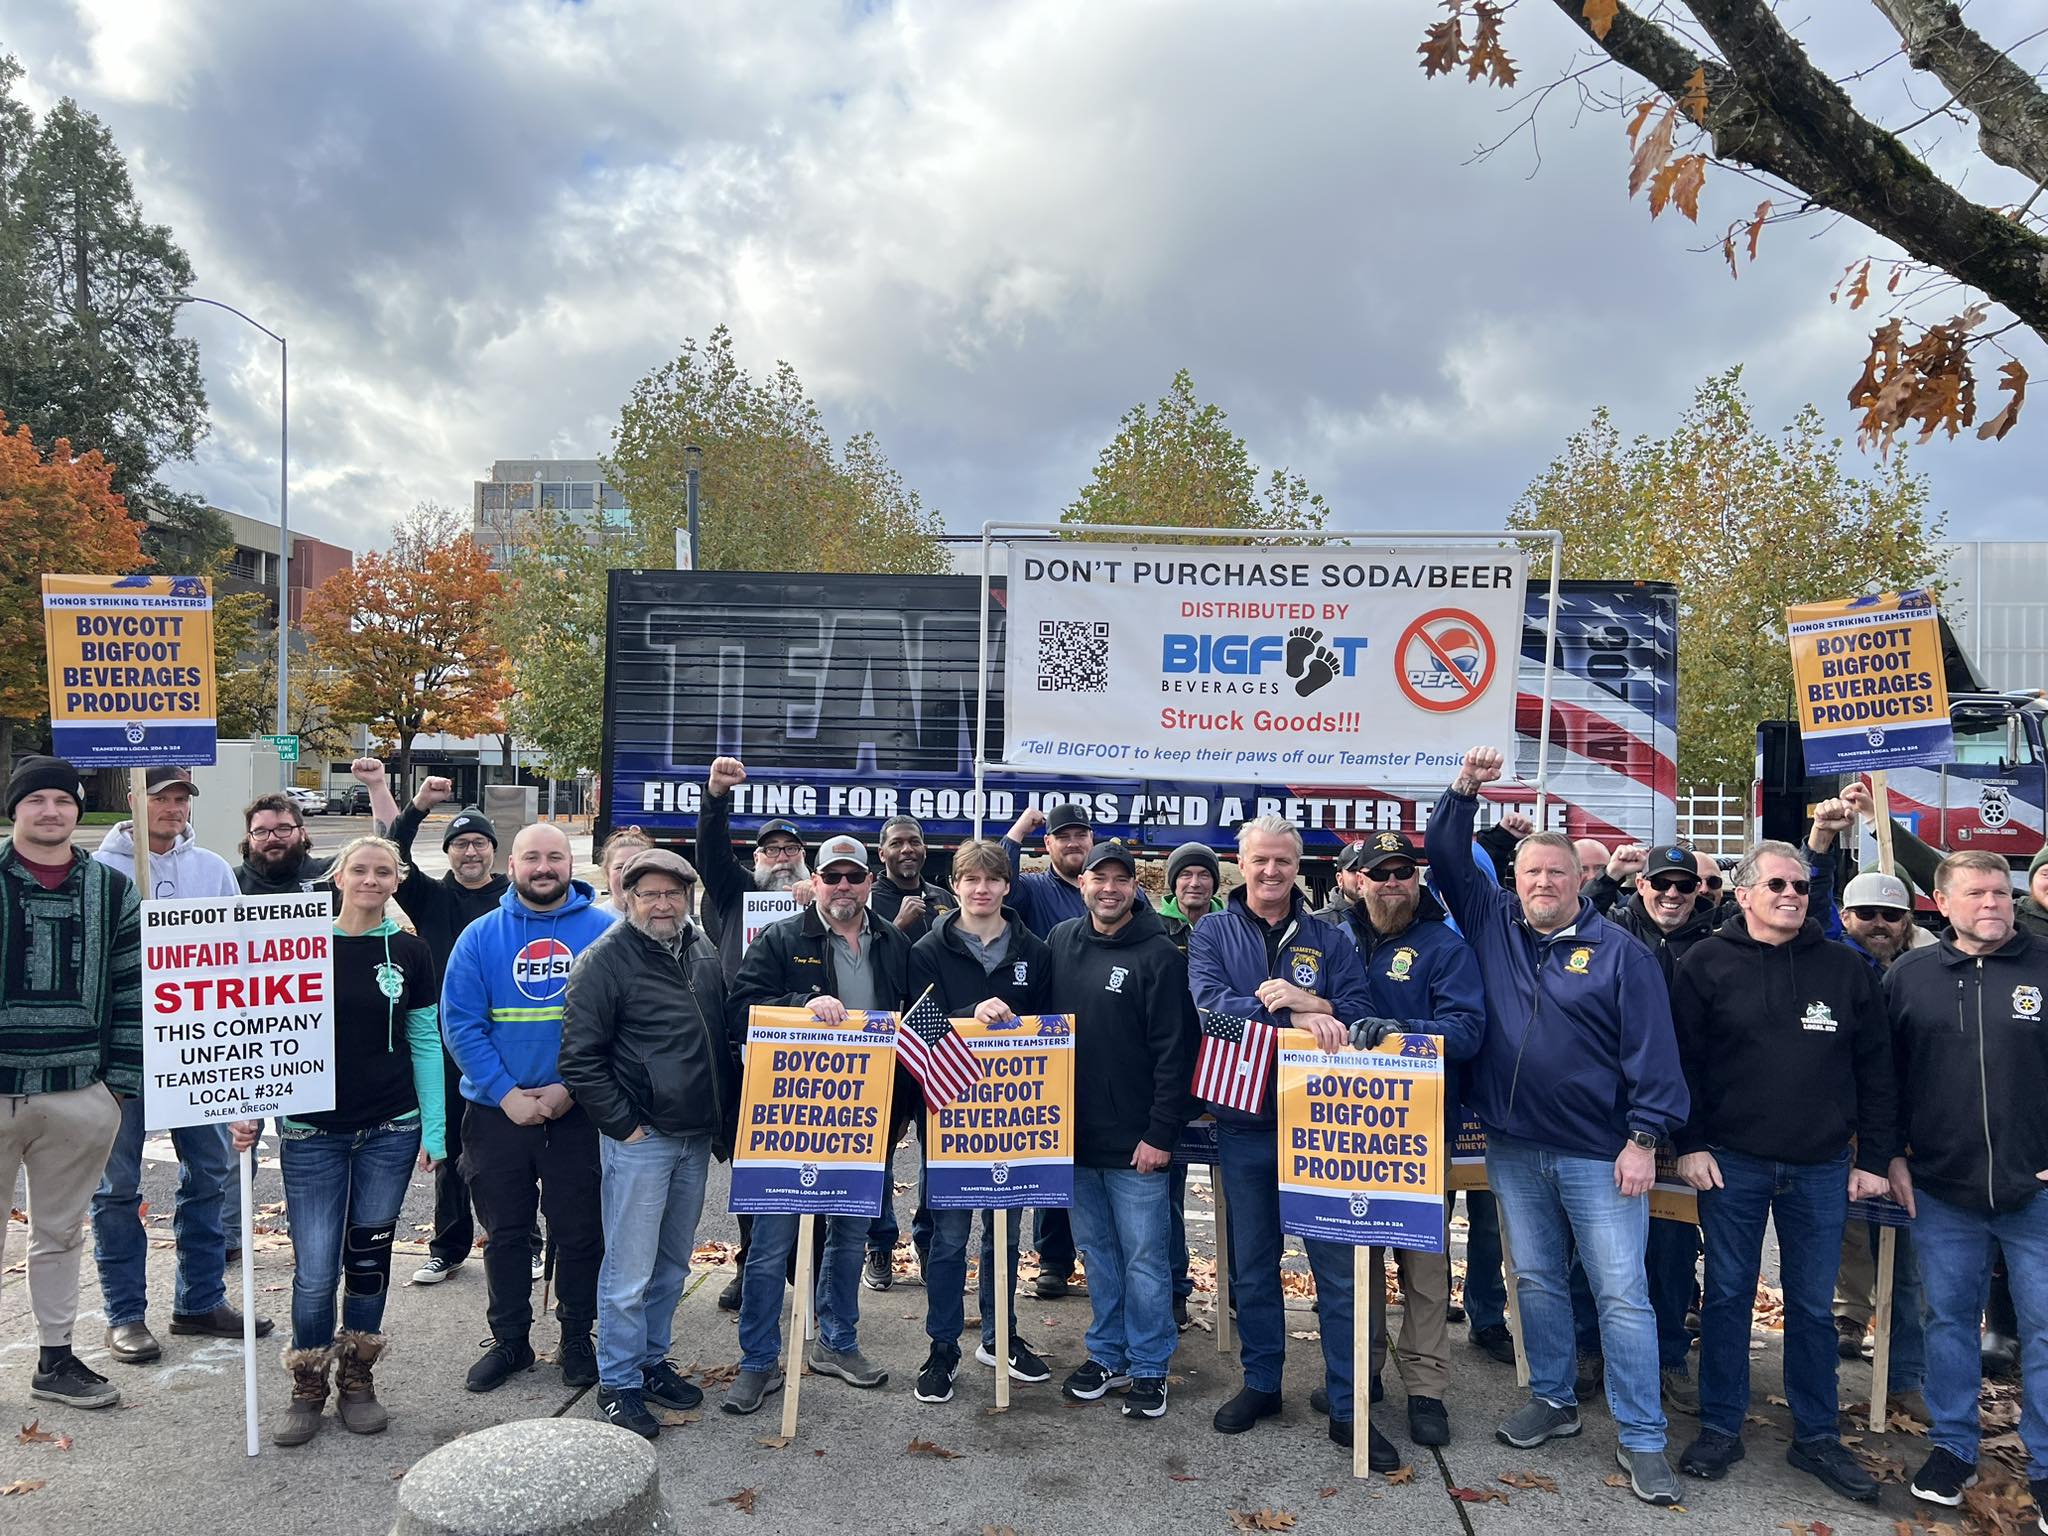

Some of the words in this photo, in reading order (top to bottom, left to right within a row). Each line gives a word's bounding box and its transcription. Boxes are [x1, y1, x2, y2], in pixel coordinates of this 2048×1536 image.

[1024, 559, 1122, 583] DON'T
[1133, 562, 1309, 586] PURCHASE
[1321, 565, 1513, 588] SODA/BEER
[50, 597, 87, 606] HONOR
[90, 598, 139, 606] STRIKING
[142, 599, 206, 607] TEAMSTERS!
[1181, 602, 1315, 619] DISTRIBUTED
[1322, 604, 1349, 620] BY
[76, 616, 183, 636] BOYCOTT
[1793, 622, 1825, 633] HONOR
[1827, 616, 1871, 629] STRIKING
[1873, 609, 1932, 622] TEAMSTERS!
[82, 641, 180, 661] BIGFOOT
[1816, 628, 1912, 657] BOYCOTT
[1822, 651, 1911, 678] BIGFOOT
[63, 667, 201, 687] BEVERAGES
[1161, 680, 1279, 695] BEVERAGES
[1808, 672, 1933, 702] BEVERAGES
[66, 692, 200, 712] PRODUCTS!
[1812, 695, 1934, 724] PRODUCTS!
[1160, 707, 1244, 730] Struck
[1253, 710, 1360, 733] Goods!!!
[276, 737, 297, 745] Center
[1057, 742, 1130, 759] BIGFOOT
[1134, 746, 1149, 759] to
[1154, 747, 1191, 762] keep
[1196, 748, 1233, 761] their
[1236, 750, 1277, 764] paws
[1282, 750, 1303, 764] off
[1307, 752, 1334, 764] our
[1339, 751, 1411, 766] Teamster
[643, 782, 817, 815] FIGTING
[828, 786, 898, 817] FOR
[910, 788, 1014, 820] GOOD
[1129, 796, 1207, 826] AND
[1219, 796, 1244, 827] A
[1257, 798, 1402, 830] BETTER
[148, 908, 227, 927] BIGFOOT
[234, 902, 327, 922] BEVERAGE
[748, 900, 797, 912] BIGFOOT
[147, 942, 238, 970] UNFAIR
[248, 936, 327, 964] LABOR
[517, 961, 570, 975] PEPSI
[154, 973, 323, 1014] STRIKE
[154, 1023, 206, 1042] THIS
[213, 1013, 323, 1038] COMPANY
[752, 1031, 787, 1040] HONOR
[789, 1032, 834, 1041] STRIKING
[837, 1034, 894, 1043] TEAMSTERS!
[181, 1042, 263, 1065] UNFAIR
[270, 1039, 299, 1056] TO
[967, 1039, 1010, 1048] STRIKING
[1013, 1038, 1069, 1048] TEAMSTERS!
[772, 1051, 870, 1074] BOYCOTT
[1284, 1053, 1318, 1063] HONOR
[1321, 1055, 1369, 1065] STRIKING
[1372, 1057, 1437, 1069] TEAMSTERS!
[155, 1065, 265, 1089] TEAMSTERS
[270, 1059, 324, 1078] UNION
[189, 1087, 250, 1105] LOCAL
[255, 1082, 293, 1099] #324
[772, 1078, 864, 1100] BIGFOOT
[957, 1080, 1044, 1103] BIGFOOT
[1306, 1074, 1413, 1101] BOYCOTT
[204, 1108, 238, 1118] SALEM,
[240, 1103, 279, 1114] OREGON
[751, 1104, 878, 1127] BEVERAGES
[940, 1105, 1061, 1128] BEVERAGES
[1310, 1102, 1409, 1128] BIGFOOT
[750, 1130, 874, 1154] PRODUCTS!
[941, 1130, 1058, 1153] PRODUCTS!
[1292, 1127, 1427, 1156] BEVERAGES
[1294, 1155, 1426, 1185] PRODUCTS!
[1315, 1216, 1351, 1225] TEAMSTERS
